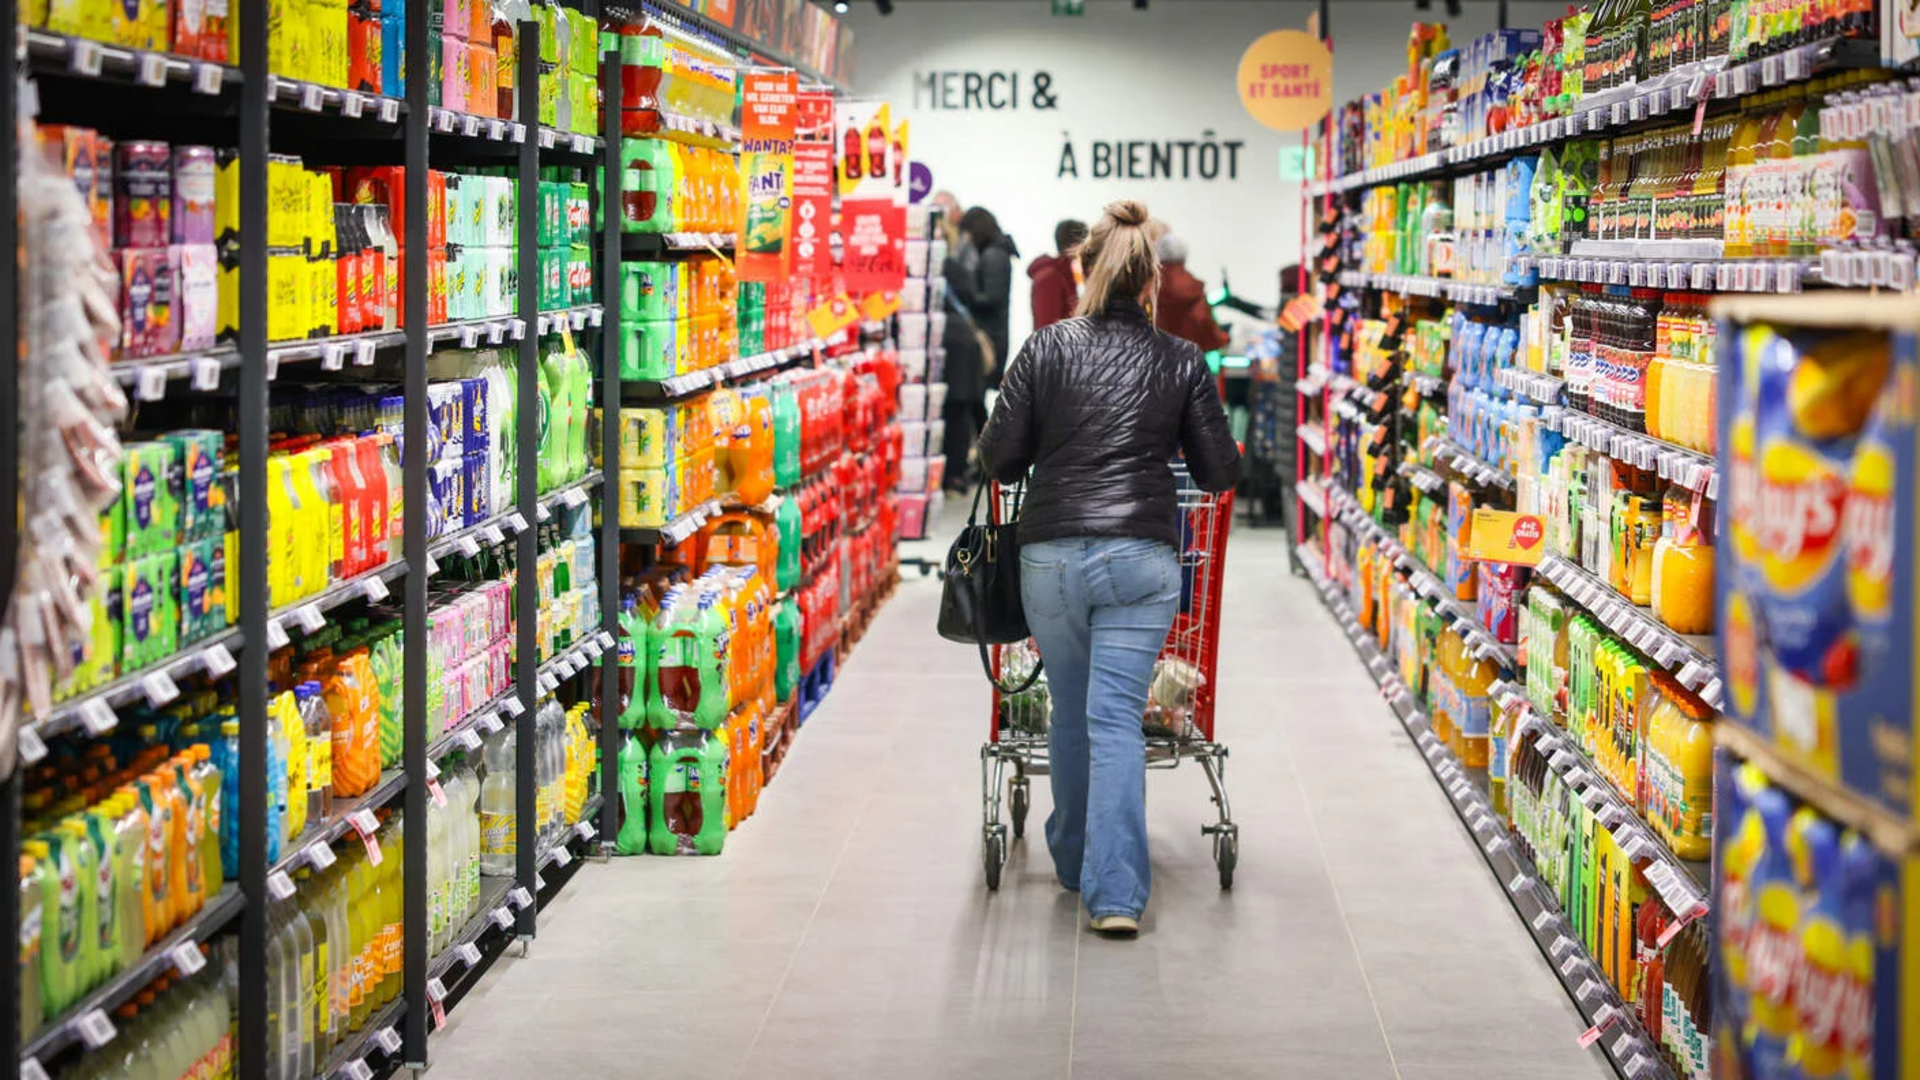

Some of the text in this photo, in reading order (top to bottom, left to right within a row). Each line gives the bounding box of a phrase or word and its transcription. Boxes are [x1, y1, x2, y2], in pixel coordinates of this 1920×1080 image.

[1260, 63, 1311, 79] SPORT
[913, 71, 1058, 109] MERCI &
[1249, 79, 1321, 99] ET SANTÉ
[743, 137, 794, 154] WANTA?
[1058, 130, 1243, 179] À BIENTÔT
[1521, 521, 1537, 531] 4+2
